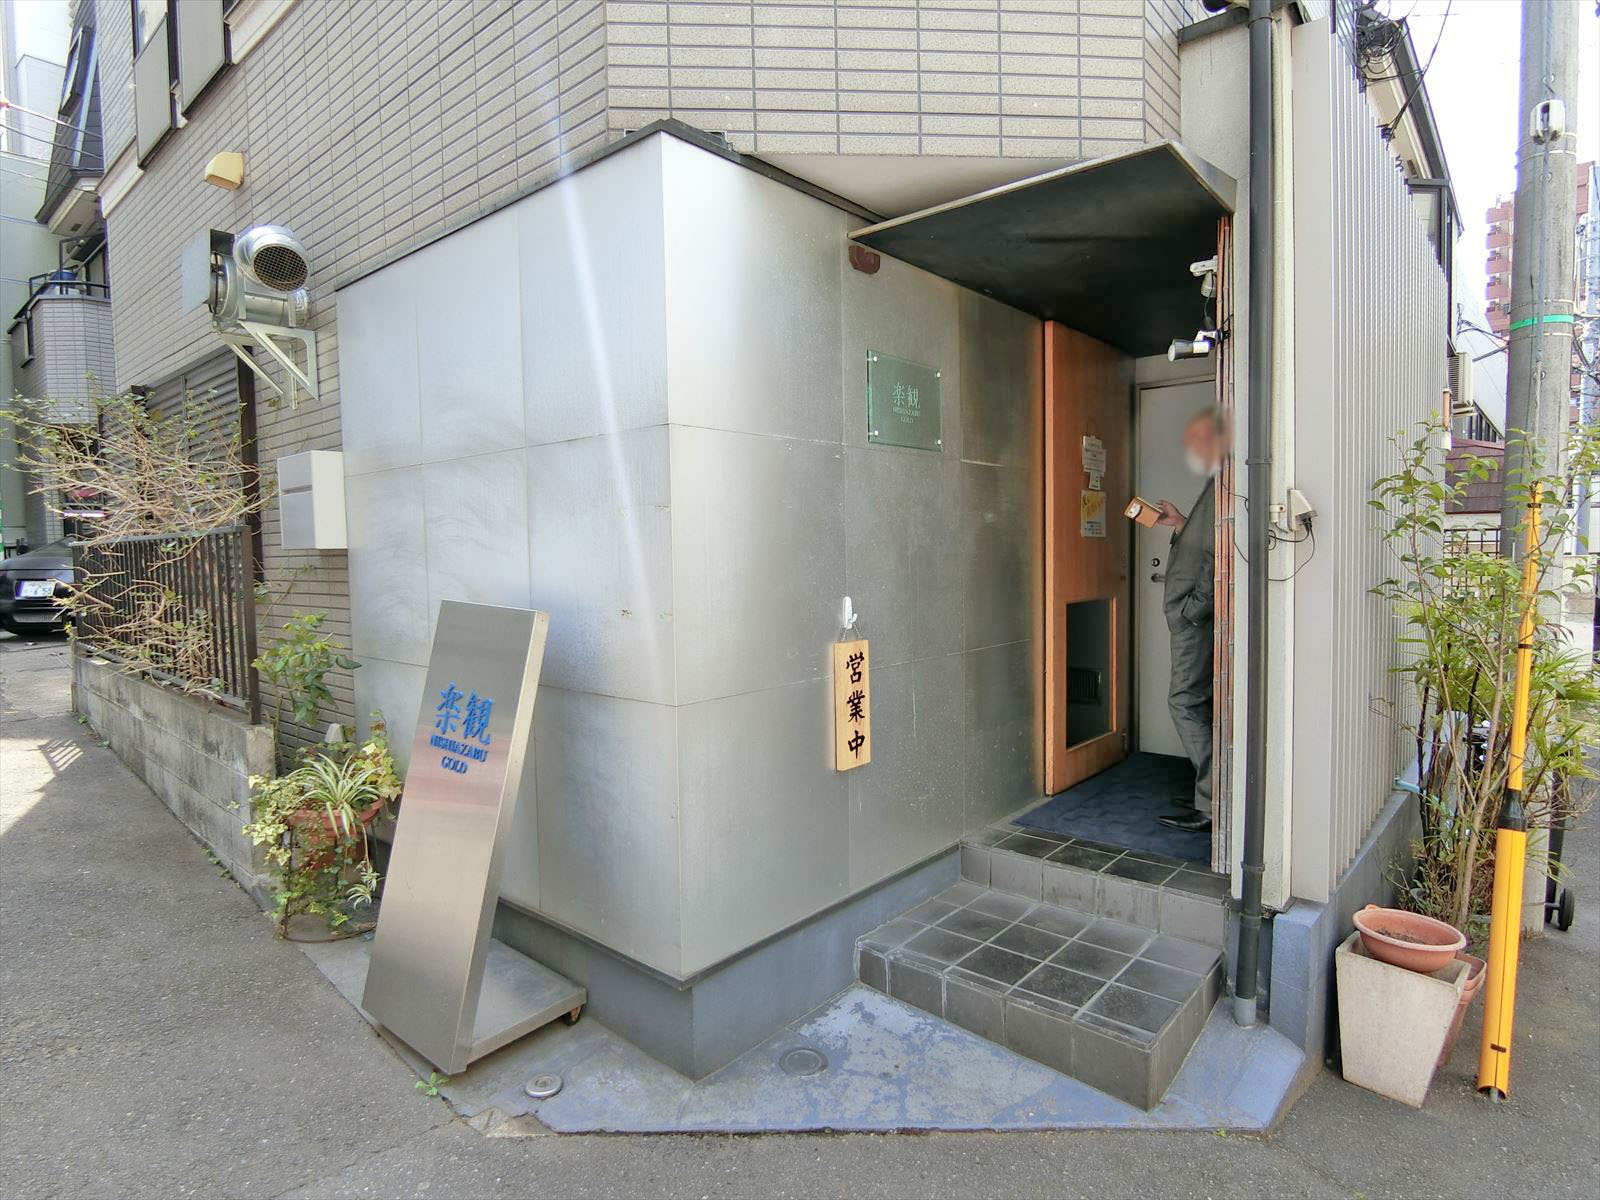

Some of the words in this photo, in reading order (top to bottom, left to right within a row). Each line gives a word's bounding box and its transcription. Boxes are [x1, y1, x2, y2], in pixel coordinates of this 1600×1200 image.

[892, 381, 920, 409] 楽観
[434, 680, 493, 746] 楽観
[846, 651, 865, 760] 営業中
[441, 755, 468, 774] GOLD
